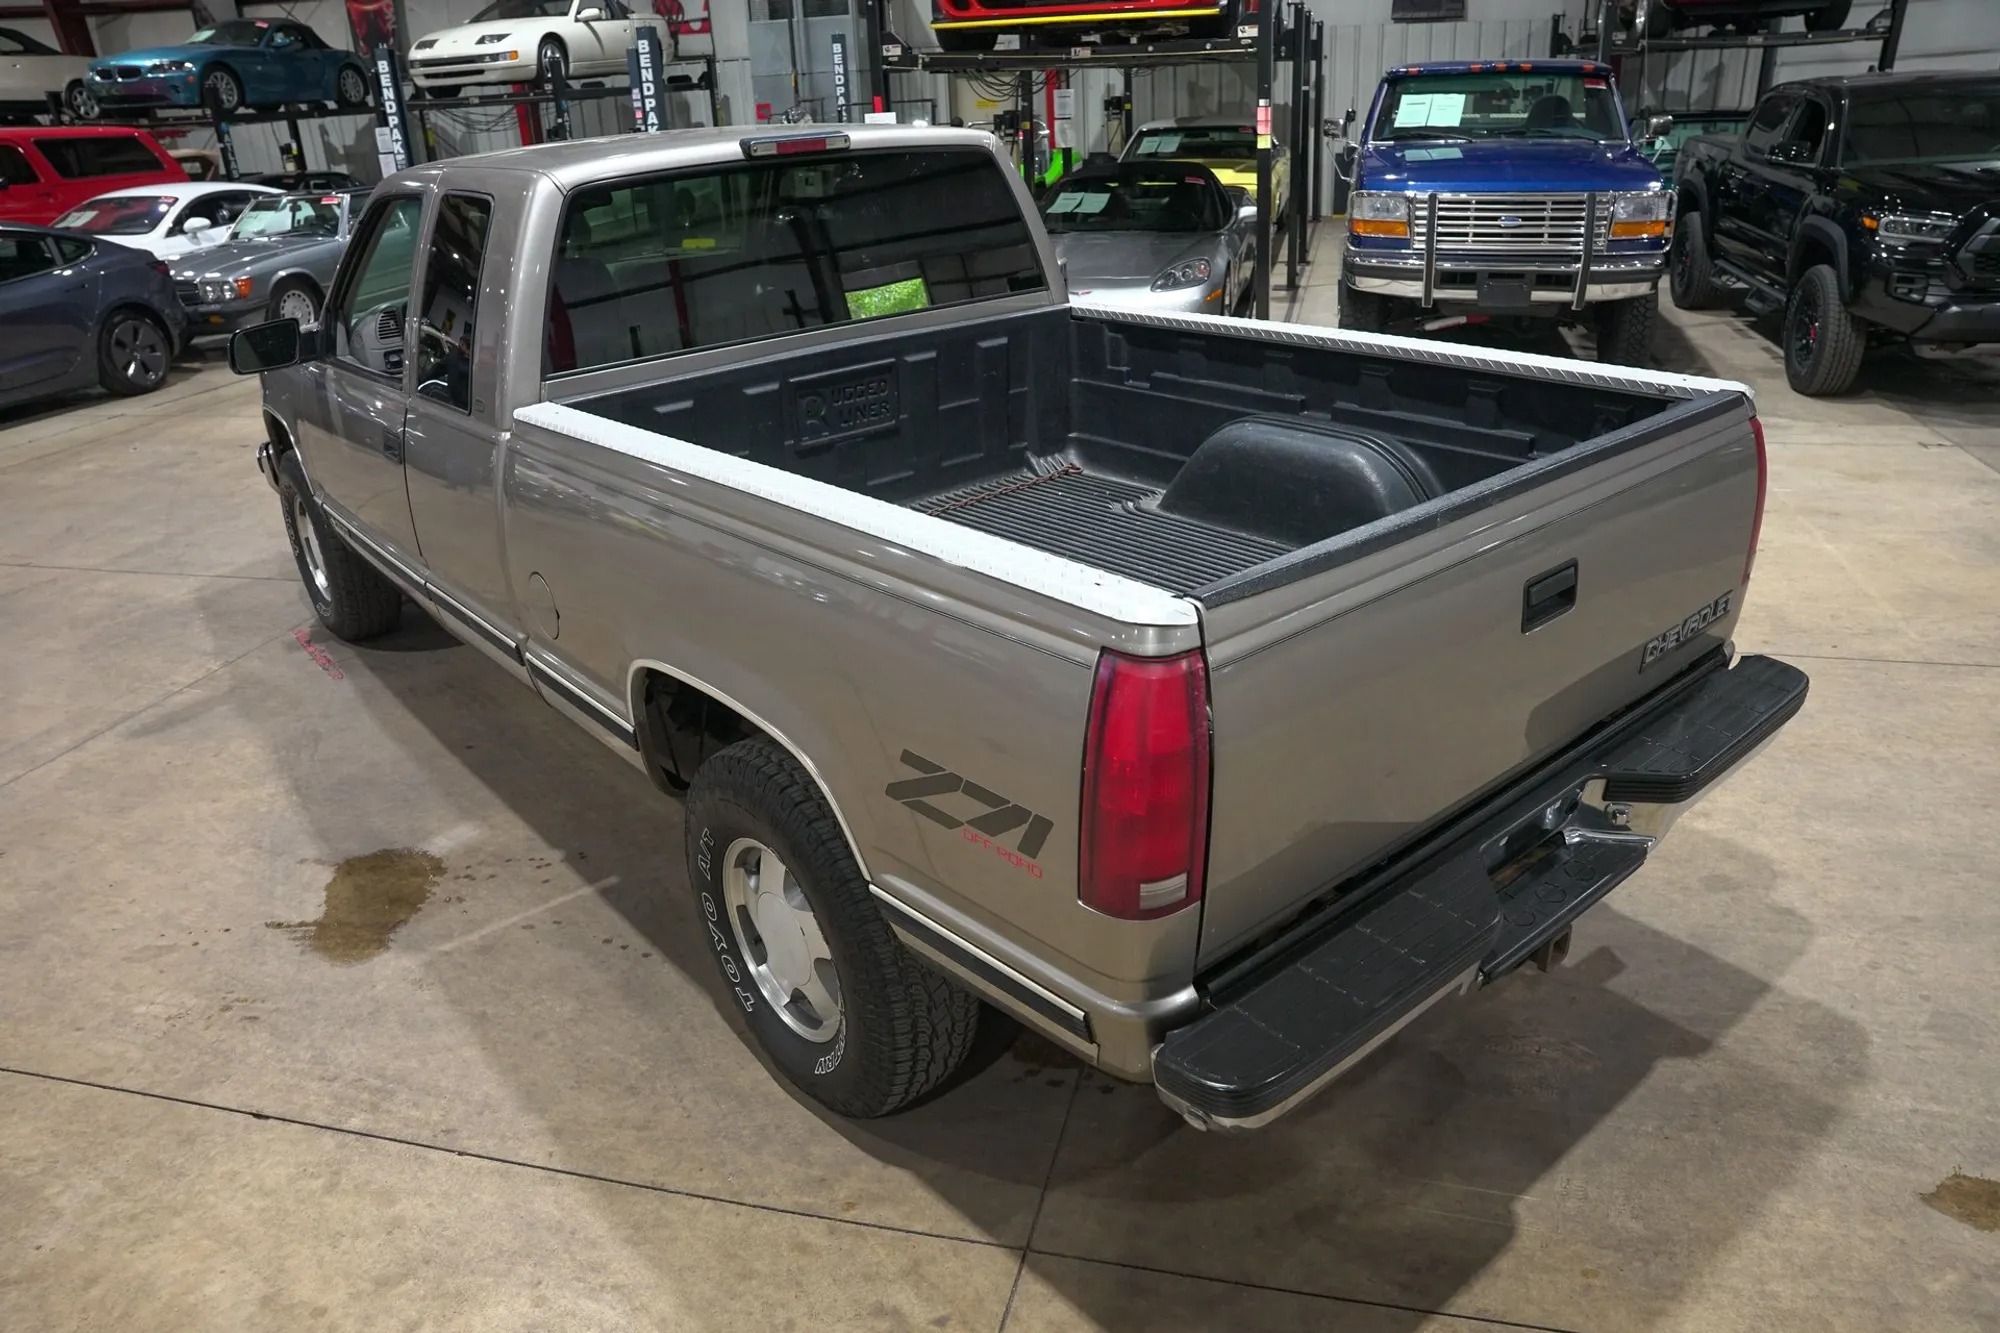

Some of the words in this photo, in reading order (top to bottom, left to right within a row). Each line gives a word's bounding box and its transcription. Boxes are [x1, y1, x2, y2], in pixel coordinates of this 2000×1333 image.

[376, 60, 405, 154] BENDPAK
[636, 39, 660, 134] BENDPAK
[1641, 589, 1734, 667] CHEVROLET
[885, 748, 1054, 859] Z71
[962, 827, 993, 849] OFF
[996, 845, 1044, 880] ROAD
[701, 892, 755, 1012] TOYO
